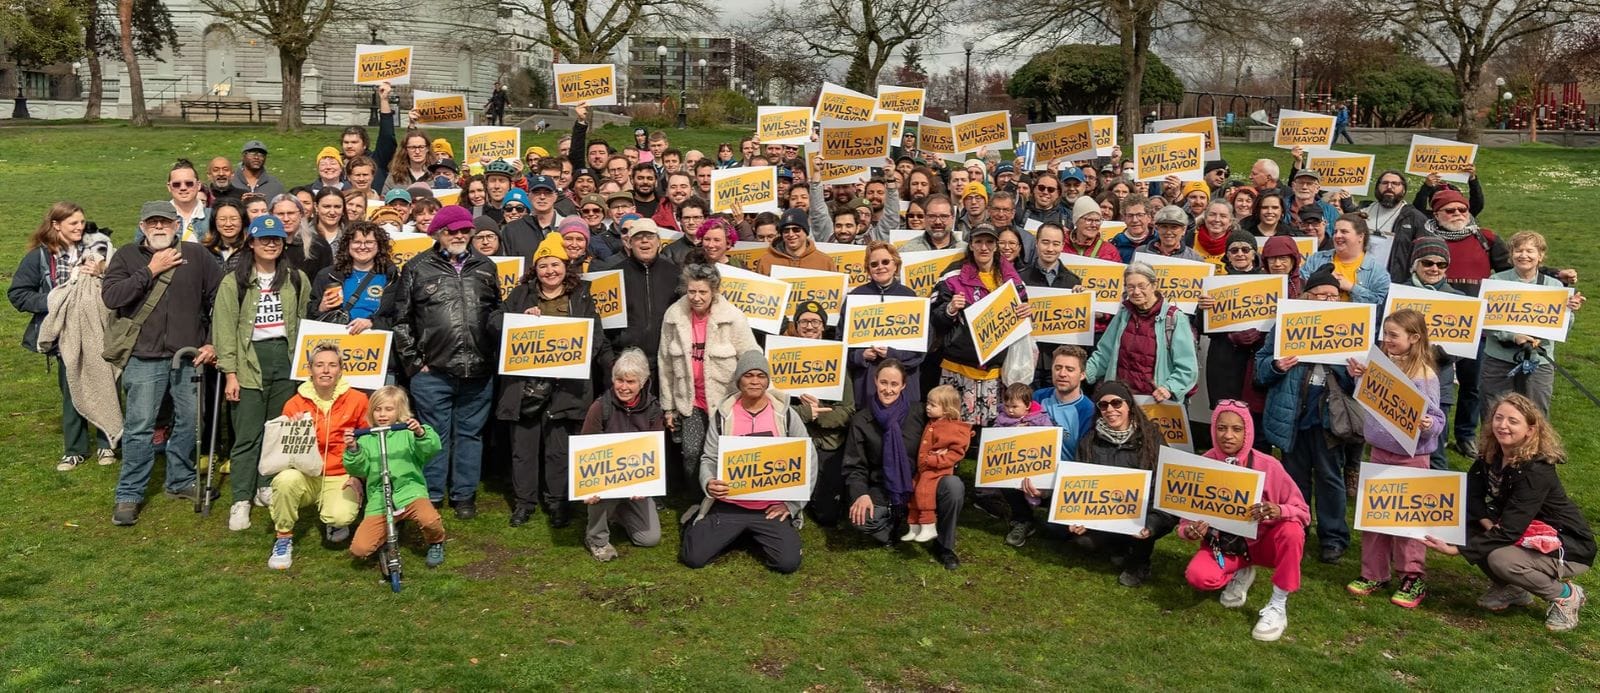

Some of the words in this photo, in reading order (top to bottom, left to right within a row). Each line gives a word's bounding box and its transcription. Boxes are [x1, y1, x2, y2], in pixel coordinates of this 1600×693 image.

[362, 54, 384, 63] KATIE
[362, 58, 406, 73] WILSON
[377, 67, 406, 78] MAYOR
[561, 74, 582, 84] KATIE
[561, 76, 609, 93] WILSON
[577, 87, 609, 98] MAYOR
[824, 95, 846, 104] KATIE
[882, 98, 920, 108] WILSON
[419, 105, 462, 116] WILSON
[823, 102, 870, 117] WILSON
[434, 113, 463, 121] MAYOR
[763, 115, 783, 123] KATIE
[763, 118, 807, 132] WILSON
[958, 122, 979, 133] KATIE
[777, 127, 807, 137] MAYOR
[827, 131, 853, 139] KATIE
[959, 122, 1004, 141] WILSON
[975, 131, 1005, 144] MAYOR
[1281, 127, 1328, 136] WILSON
[469, 139, 514, 154] WILSON
[827, 136, 884, 149] WILSON
[1036, 132, 1087, 151] WILSON
[844, 147, 883, 156] MAYOR
[1054, 141, 1089, 156] MAYOR
[1141, 144, 1167, 155] KATIE
[1141, 147, 1197, 166] WILSON
[1416, 154, 1468, 164] WILSON
[1160, 159, 1197, 172] MAYOR
[718, 178, 741, 189] KATIE
[1327, 176, 1363, 184] MAYOR
[718, 179, 770, 199] WILSON
[909, 263, 937, 277] KATIE
[792, 280, 806, 290] TIE
[592, 288, 618, 304] SON
[788, 288, 839, 302] ILSON
[1095, 290, 1118, 299] YOR
[1210, 288, 1239, 300] KATIE
[1488, 294, 1521, 302] KATIE
[256, 303, 282, 313] THE
[597, 302, 618, 314] YOR
[1030, 300, 1052, 310] ATIE
[1212, 292, 1277, 314] WILSON
[1487, 302, 1562, 314] WILSON
[254, 314, 283, 323] RICH
[854, 307, 884, 318] KATIE
[1210, 312, 1227, 322] FOR
[1231, 305, 1277, 320] MAYOR
[854, 312, 920, 329] WILSON
[975, 307, 994, 331] KATIE
[978, 297, 1019, 343] WILSON
[1287, 315, 1321, 327] KATIE
[1507, 315, 1559, 324] MAYOR
[874, 326, 919, 337] MAYOR
[1042, 320, 1086, 332] MAYOR
[1286, 322, 1364, 340] WILSON
[512, 330, 545, 341] KATIE
[1428, 328, 1469, 339] AYOR
[512, 336, 583, 355] WILSON
[1310, 337, 1363, 350] MAYOR
[306, 348, 380, 361] SON
[509, 356, 529, 364] FOR
[533, 351, 582, 364] MAYOR
[772, 351, 802, 361] KATIE
[342, 362, 377, 372] AYOR
[771, 359, 838, 375] WILSON
[790, 373, 836, 385] MAYOR
[1369, 366, 1394, 390] KATIE
[1367, 375, 1419, 422] WILSON
[1362, 387, 1377, 403] FOR
[1378, 400, 1414, 433] MAYOR
[289, 427, 300, 435] IS
[303, 427, 310, 435] A
[281, 436, 316, 445] HUMAN
[282, 445, 312, 454] RIGHT
[987, 440, 1016, 454] KATIE
[580, 448, 613, 464] KATIE
[728, 452, 761, 466] KATIE
[987, 444, 1052, 467] WILSON
[580, 450, 654, 478] WILSON
[728, 456, 801, 480] WILSON
[985, 467, 1002, 476] FOR
[1006, 459, 1051, 475] MAYOR
[579, 478, 600, 488] FOR
[605, 466, 655, 485] MAYOR
[751, 472, 800, 488] MAYOR
[1168, 469, 1204, 483] KATIE
[1064, 480, 1099, 489] KATIE
[1370, 483, 1408, 494] KATIE
[1064, 489, 1139, 504] WILSON
[1167, 479, 1249, 505] WILSON
[1165, 494, 1186, 504] FOR
[1191, 499, 1247, 517] MAYOR
[1369, 493, 1454, 510] WILSON
[1085, 505, 1137, 515] MAYOR
[1395, 511, 1453, 522] MAYOR
